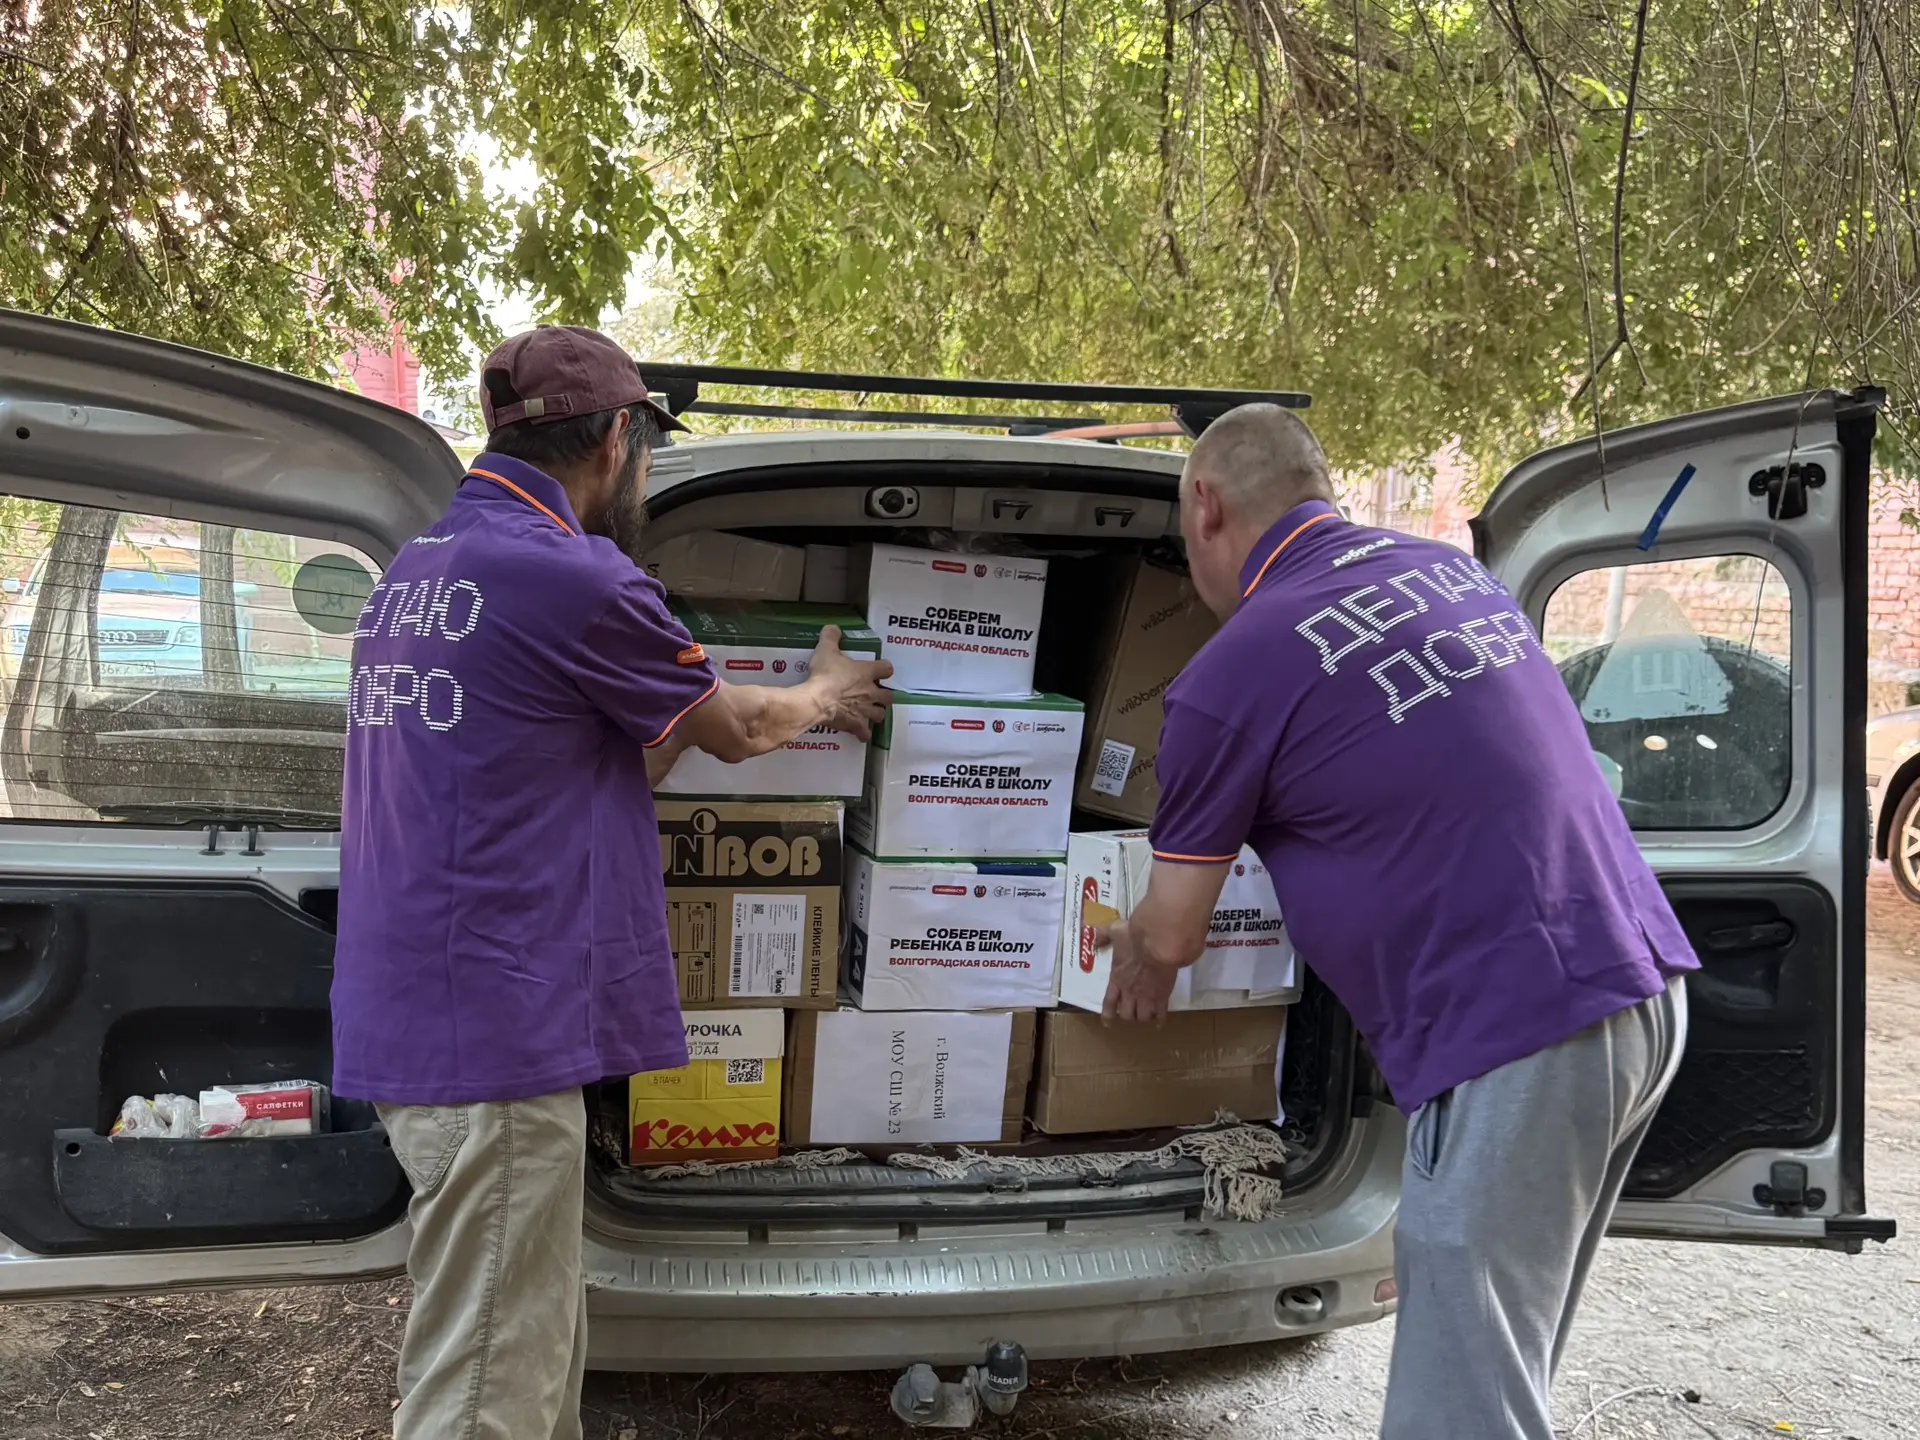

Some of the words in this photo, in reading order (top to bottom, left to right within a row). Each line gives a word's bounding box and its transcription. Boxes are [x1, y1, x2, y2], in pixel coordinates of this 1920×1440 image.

[353, 577, 484, 642] ЕЛАЮ
[925, 606, 1001, 626] СОБЕРЕМ
[888, 614, 962, 635] РЕБЕНКА
[964, 622, 975, 635] В
[977, 625, 1034, 642] ШКОЛУ
[886, 634, 980, 653] ВОЛГОГРАДСКАЯ
[980, 644, 1030, 659] ОБЛАСТЬ
[1367, 610, 1548, 724] ДОБР
[347, 664, 464, 732] ОБРО
[786, 741, 840, 750] ОБЛАСТЬ
[945, 763, 1021, 778] СОБЕРЕМ
[908, 774, 982, 789] РЕБЕНКА
[984, 776, 995, 789] В
[998, 778, 1052, 790] ШКОЛУ
[908, 794, 1000, 806] ВОЛГОГРАДСКАЯ
[1001, 796, 1049, 807] ОБЛАСТЬ
[1211, 908, 1261, 921] ОБЕРЕМ
[811, 905, 823, 956] КЛЕЙКИЕ
[1232, 921, 1242, 933] В
[1243, 919, 1284, 932] ШКОЛУ
[926, 927, 1002, 941] СОБЕРЕМ
[889, 938, 963, 952] РЕБЕНКА
[965, 939, 976, 952] В
[978, 941, 1035, 953] ШКОЛУ
[888, 956, 981, 969] ВОЛГОГРАДСКАЯ
[982, 959, 1031, 969] ОБЛАСТЬ
[810, 958, 821, 998] ЛЕНТЫ
[684, 1024, 743, 1037] УРОЧКА
[891, 1030, 905, 1066] МОУ
[889, 1070, 903, 1096] СШ
[933, 1052, 949, 1120] Волжский
[256, 1101, 304, 1110] САЛФЕТКИ
[888, 1102, 902, 1116] №
[888, 1120, 901, 1134] 23
